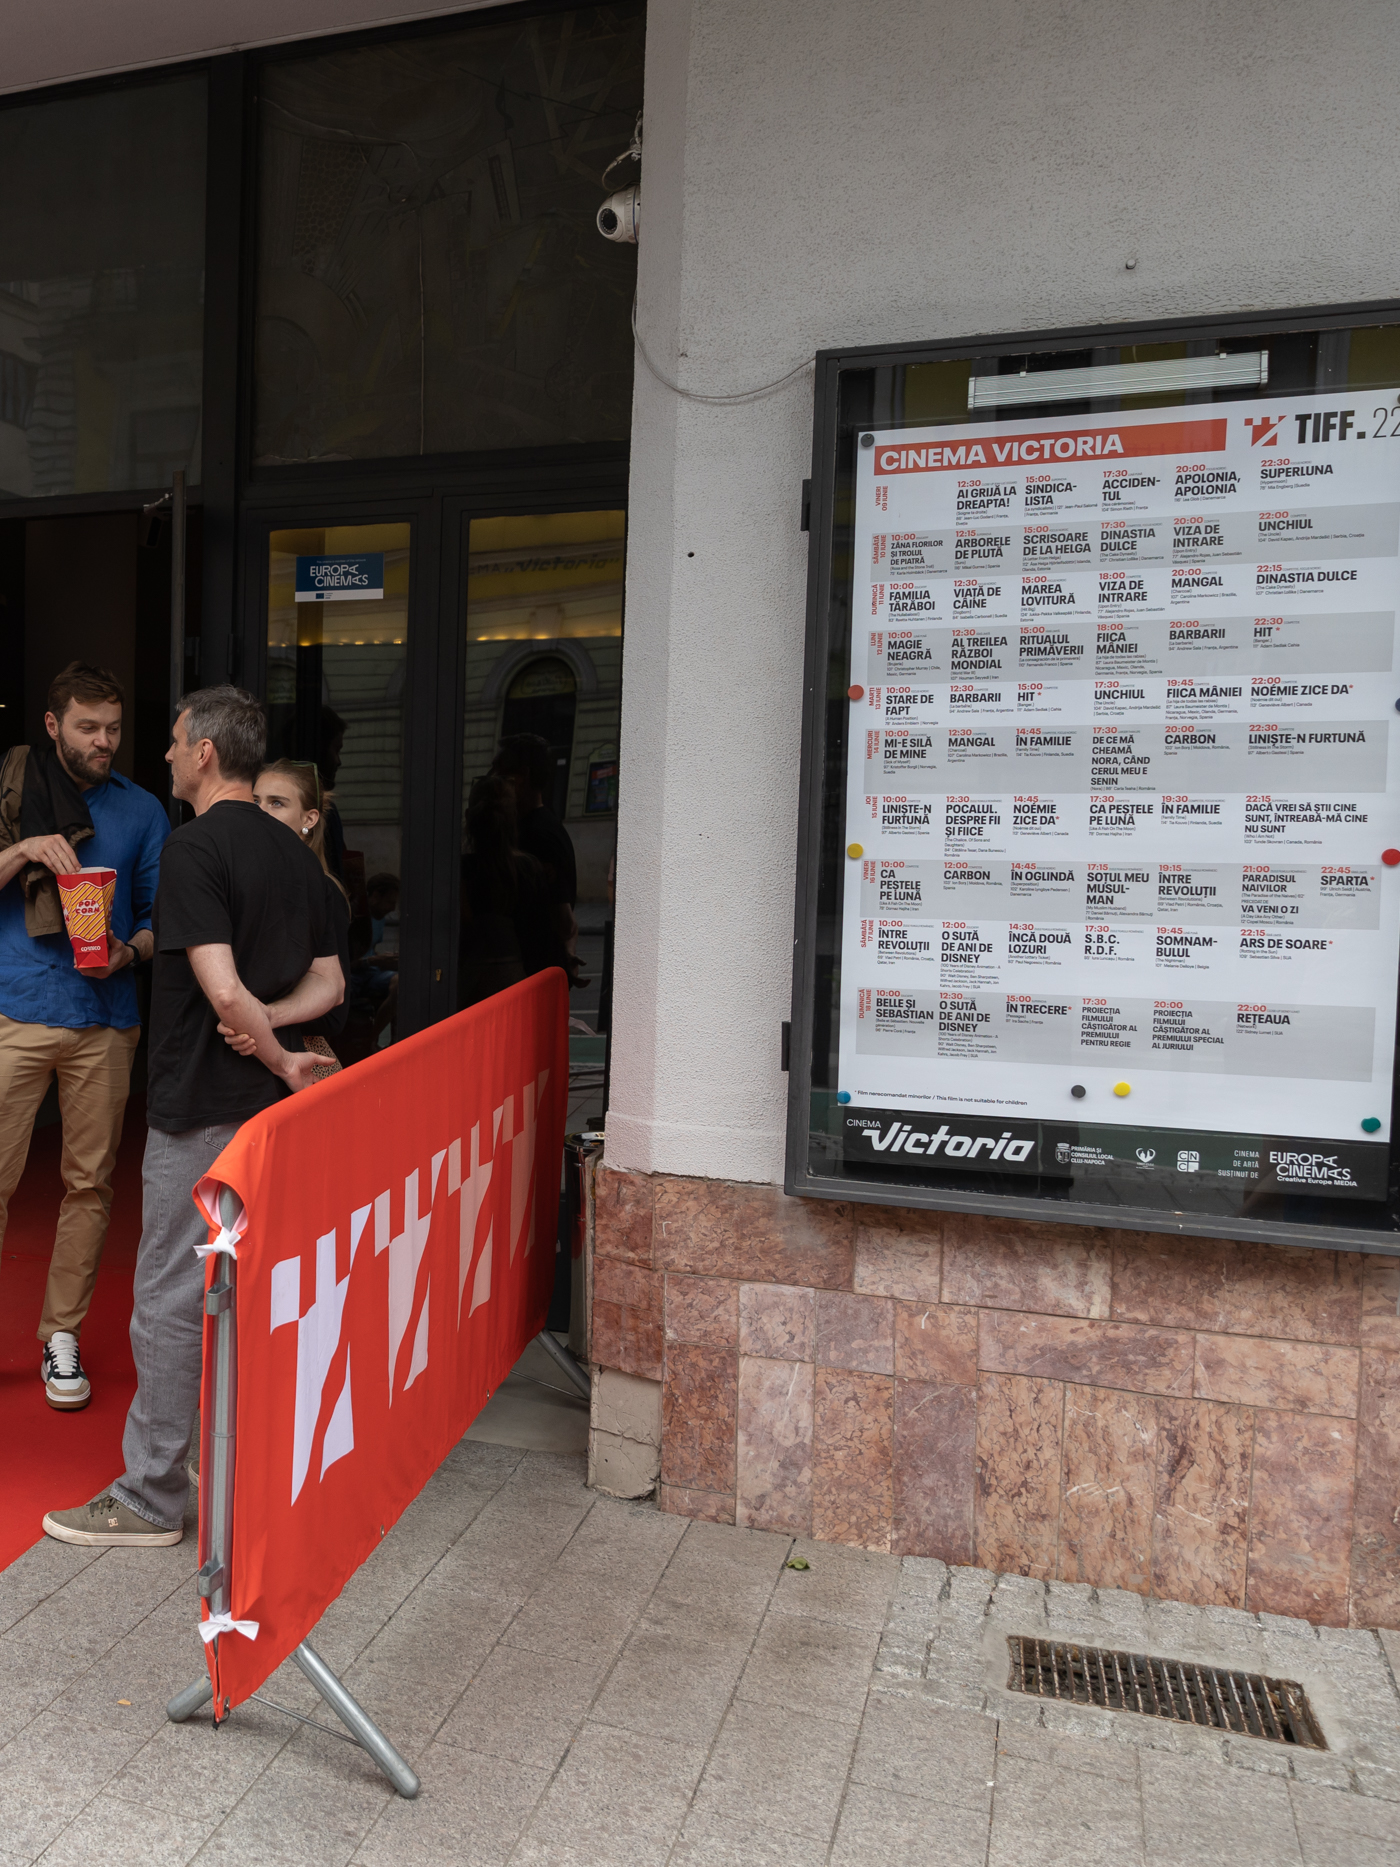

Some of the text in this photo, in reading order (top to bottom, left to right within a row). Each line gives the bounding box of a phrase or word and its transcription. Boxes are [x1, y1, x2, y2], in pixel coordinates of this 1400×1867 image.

[880, 434, 1124, 472] CINEMA VICTORIA
[1176, 464, 1205, 472] 20:00
[1261, 465, 1333, 479] SUPERLUNA
[1103, 477, 1160, 489] ACCIDEN-
[1175, 471, 1241, 484] APOLONIA,
[957, 485, 1017, 499] AI GRIJĂ LA
[1025, 483, 1077, 494] SINDICA-
[1175, 484, 1237, 496] APOLONIA
[1025, 495, 1053, 506] LISTA
[1102, 491, 1121, 501] TUL
[957, 498, 1010, 510] DREAPTA!
[1174, 525, 1219, 536] VIZA DE
[1259, 519, 1313, 531] UNCHIUL
[1023, 532, 1088, 544] SCRISOARE
[1101, 528, 1155, 540] DINASTIA
[891, 541, 910, 549] ZÂNA
[955, 536, 1011, 549] ARBORELE
[1101, 541, 1137, 551] DULCE
[1173, 536, 1223, 547] INTRARE
[970, 547, 1003, 559] PLUTĂ
[1055, 544, 1091, 555] HELGA
[310, 564, 359, 576] EUROPA
[315, 574, 368, 587] CINEMAS
[1257, 570, 1357, 584] DINASTIA DULCE
[953, 586, 985, 598] VIAȚĂ
[1022, 584, 1062, 594] MAREA
[889, 591, 930, 601] FAMILIA
[1022, 593, 1075, 606] LOVITURĂ
[889, 600, 935, 612] TĂRĂBOI
[1020, 635, 1069, 645] RITUALUL
[1169, 629, 1225, 640] BARBARII
[888, 640, 922, 650] MAGIE
[966, 637, 1008, 647] TREILEA
[1020, 644, 1083, 656] PRIMĂVERII
[1096, 642, 1137, 654] MÂNIEI
[888, 649, 932, 661] NEAGRĂ
[951, 660, 1002, 670] MONDIAL
[1167, 686, 1242, 698] FIICA MÂNIEI
[1251, 684, 1328, 696] NOÉMIE ZICE
[886, 694, 934, 704] STARE DE
[886, 706, 911, 715] FAPT
[885, 736, 932, 748] MI-E SILĂ
[1165, 734, 1215, 744] CARBON
[1249, 731, 1365, 747] LINIȘTE-N FURTUNĂ
[1092, 745, 1132, 754] CHEAMĂ
[946, 804, 997, 814] POCALUL.
[1275, 804, 1297, 812] VREI
[946, 815, 986, 825] DESPRE
[1274, 812, 1368, 823] ÎNTREABĂ-MĂ CINE
[1025, 870, 1075, 881] OGLINDĂ
[1087, 872, 1122, 884] SOȚUL
[1242, 874, 1296, 883] PARADISUL
[1320, 876, 1368, 886] SPARTA
[1159, 886, 1216, 898] REVOLUȚII
[1242, 884, 1287, 892] NAIVILOR
[1085, 934, 1119, 944] S.B.C.
[1156, 936, 1217, 946] SOMNAM-
[1240, 938, 1327, 949] ARS DE SOARE
[1009, 944, 1047, 954] LOZURI
[1156, 947, 1190, 958] BULUL
[876, 1009, 933, 1020] SEBASTIAN
[1237, 1013, 1290, 1026] REȚEAUA
[939, 1022, 978, 1032] DISNEY
[1153, 1034, 1224, 1044] PREMIULUI SPECIAL
[846, 1119, 881, 1129] CINEMA
[862, 1122, 1035, 1162] Victoria
[1234, 1150, 1260, 1158] CINEMA
[1270, 1151, 1338, 1166] EUROPA
[1242, 1160, 1259, 1168] ARTĂ
[1276, 1164, 1350, 1180] CINEMAS
[1277, 1175, 1306, 1183] Creative
[1308, 1178, 1332, 1186] Europe
